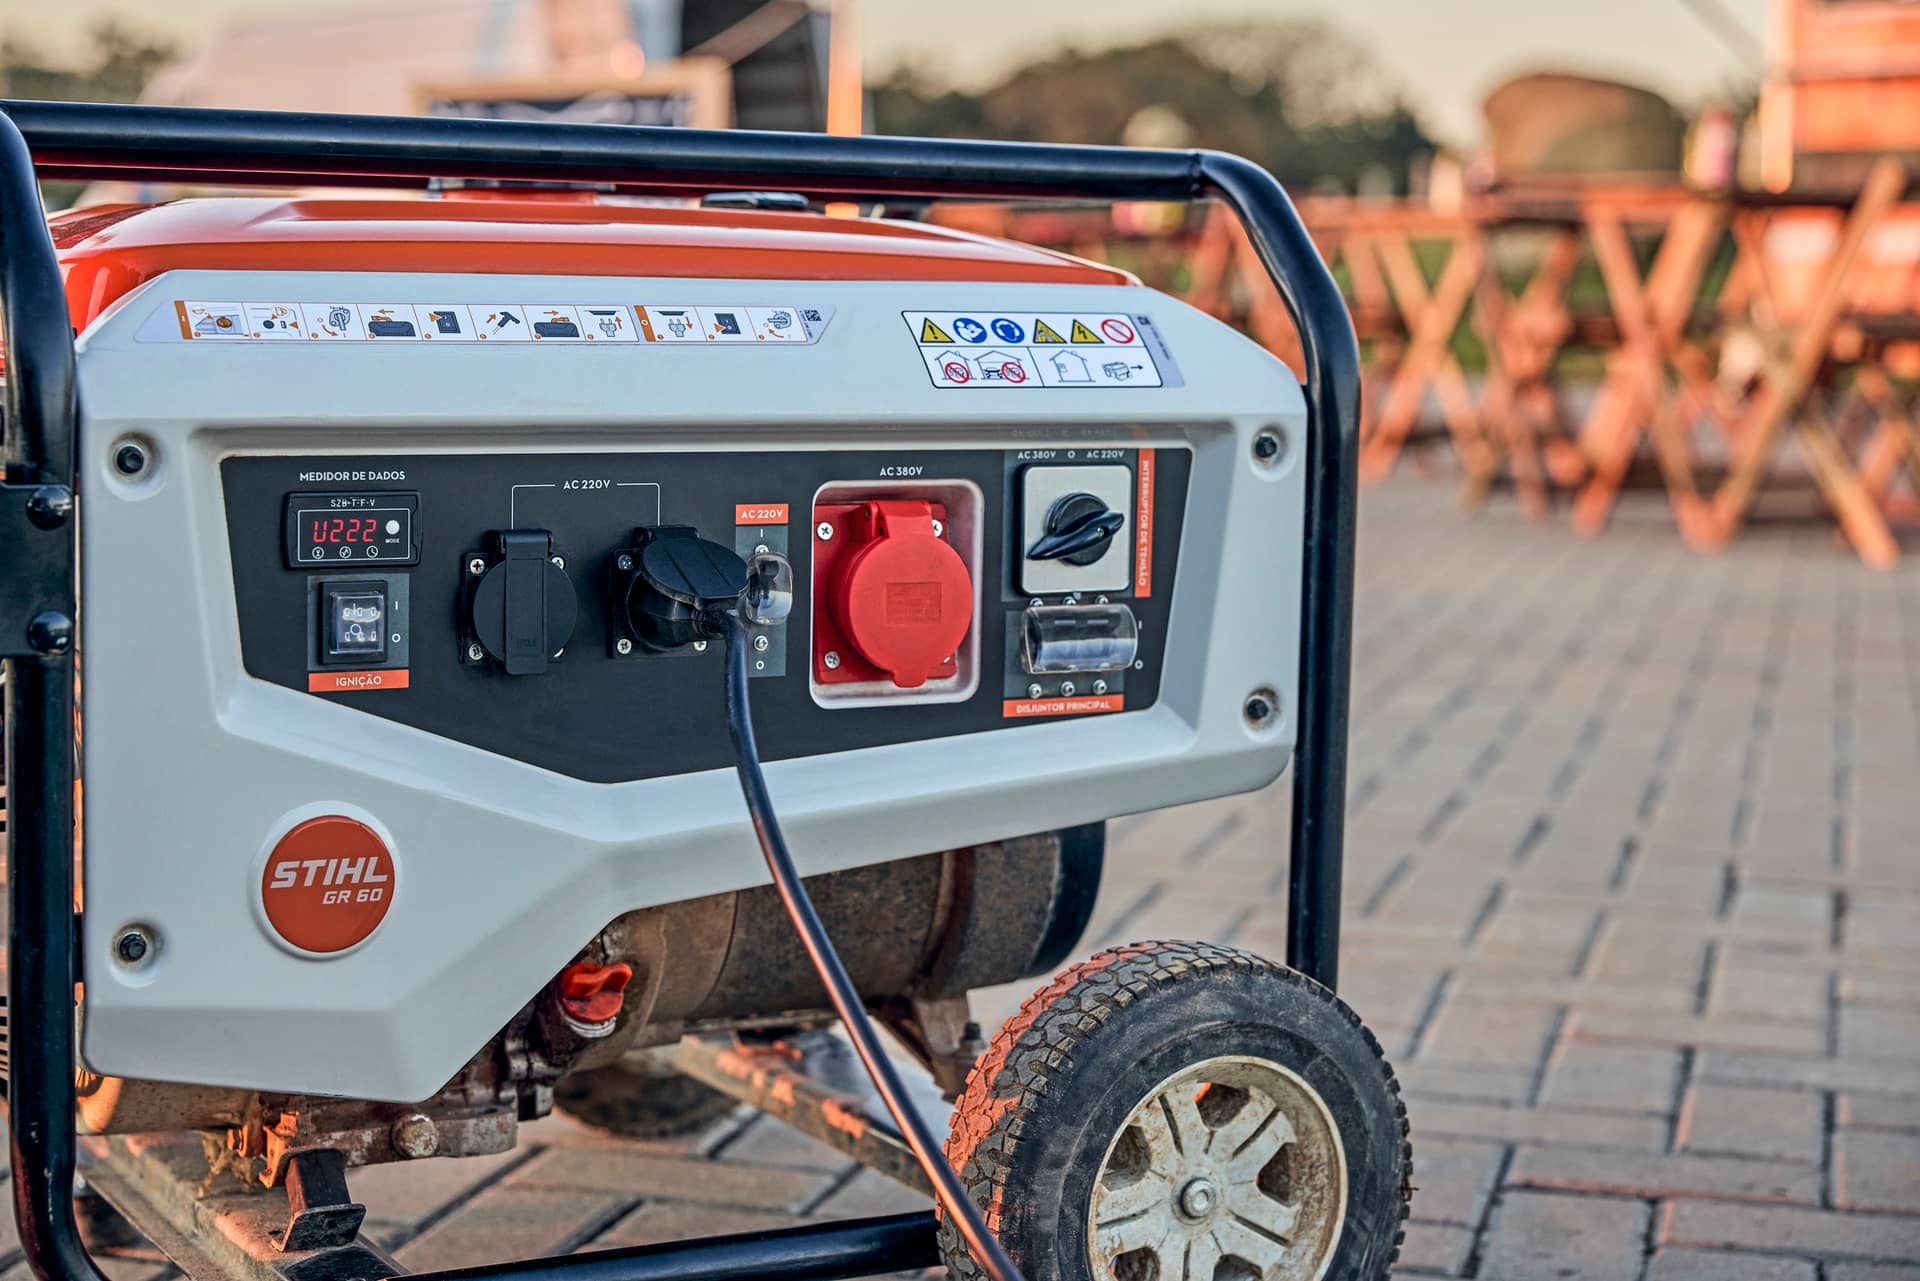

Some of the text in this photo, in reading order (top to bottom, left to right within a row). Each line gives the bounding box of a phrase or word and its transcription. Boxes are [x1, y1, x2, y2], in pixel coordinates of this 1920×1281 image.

[1018, 451, 1031, 459] AC
[1032, 450, 1056, 459] 380V
[1086, 450, 1100, 458] AC
[1101, 450, 1125, 458] 220V
[300, 471, 406, 481] MEDIDOR DE DADOS
[880, 466, 923, 476] AC 380V
[564, 480, 610, 490] AC 220V
[741, 508, 784, 519] AC 220V
[313, 519, 377, 543] U222
[336, 674, 382, 688] IGNIÇÃO
[1016, 700, 1110, 713] DISJUNTOR PRINCIPAL
[270, 856, 388, 888] STIHL
[322, 888, 384, 904] GR 60
